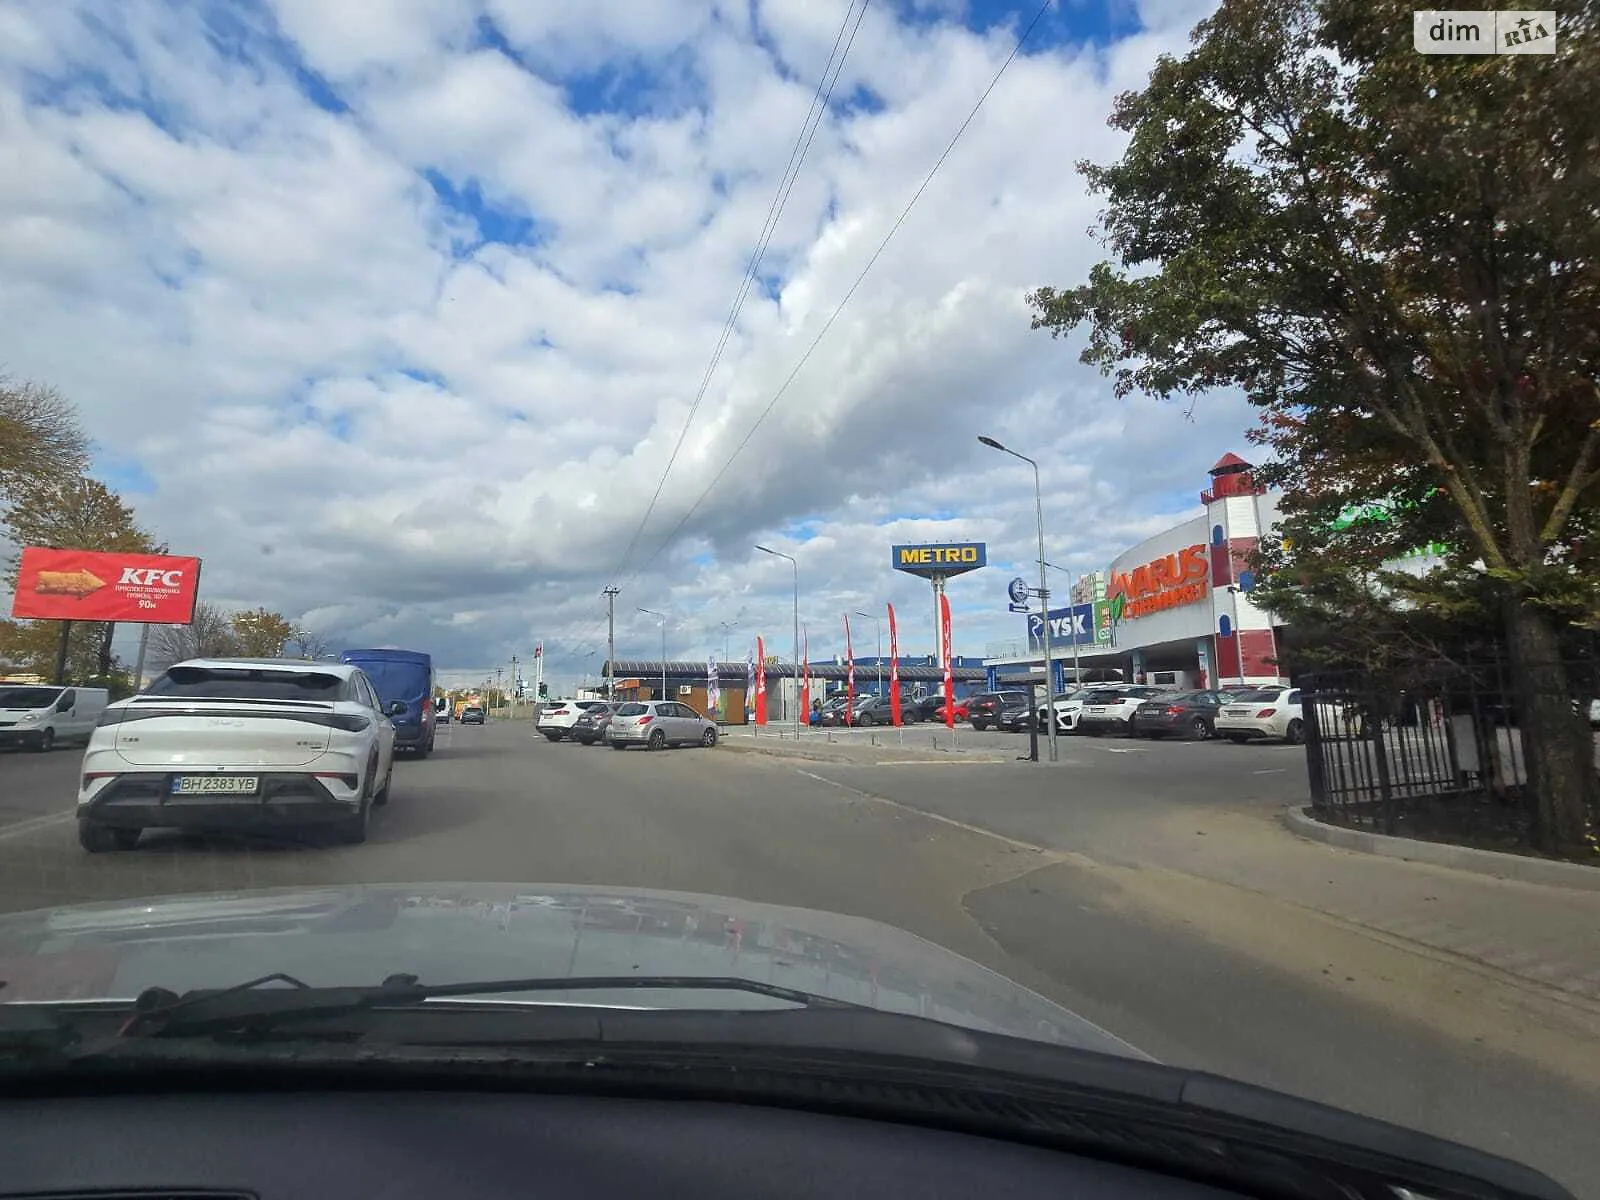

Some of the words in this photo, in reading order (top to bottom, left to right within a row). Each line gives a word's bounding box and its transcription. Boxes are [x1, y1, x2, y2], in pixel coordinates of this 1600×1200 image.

[901, 547, 977, 563] METRO
[118, 567, 183, 586] KFC
[1119, 544, 1209, 599] VARUS
[182, 779, 201, 789] BH
[203, 779, 234, 789] 2383
